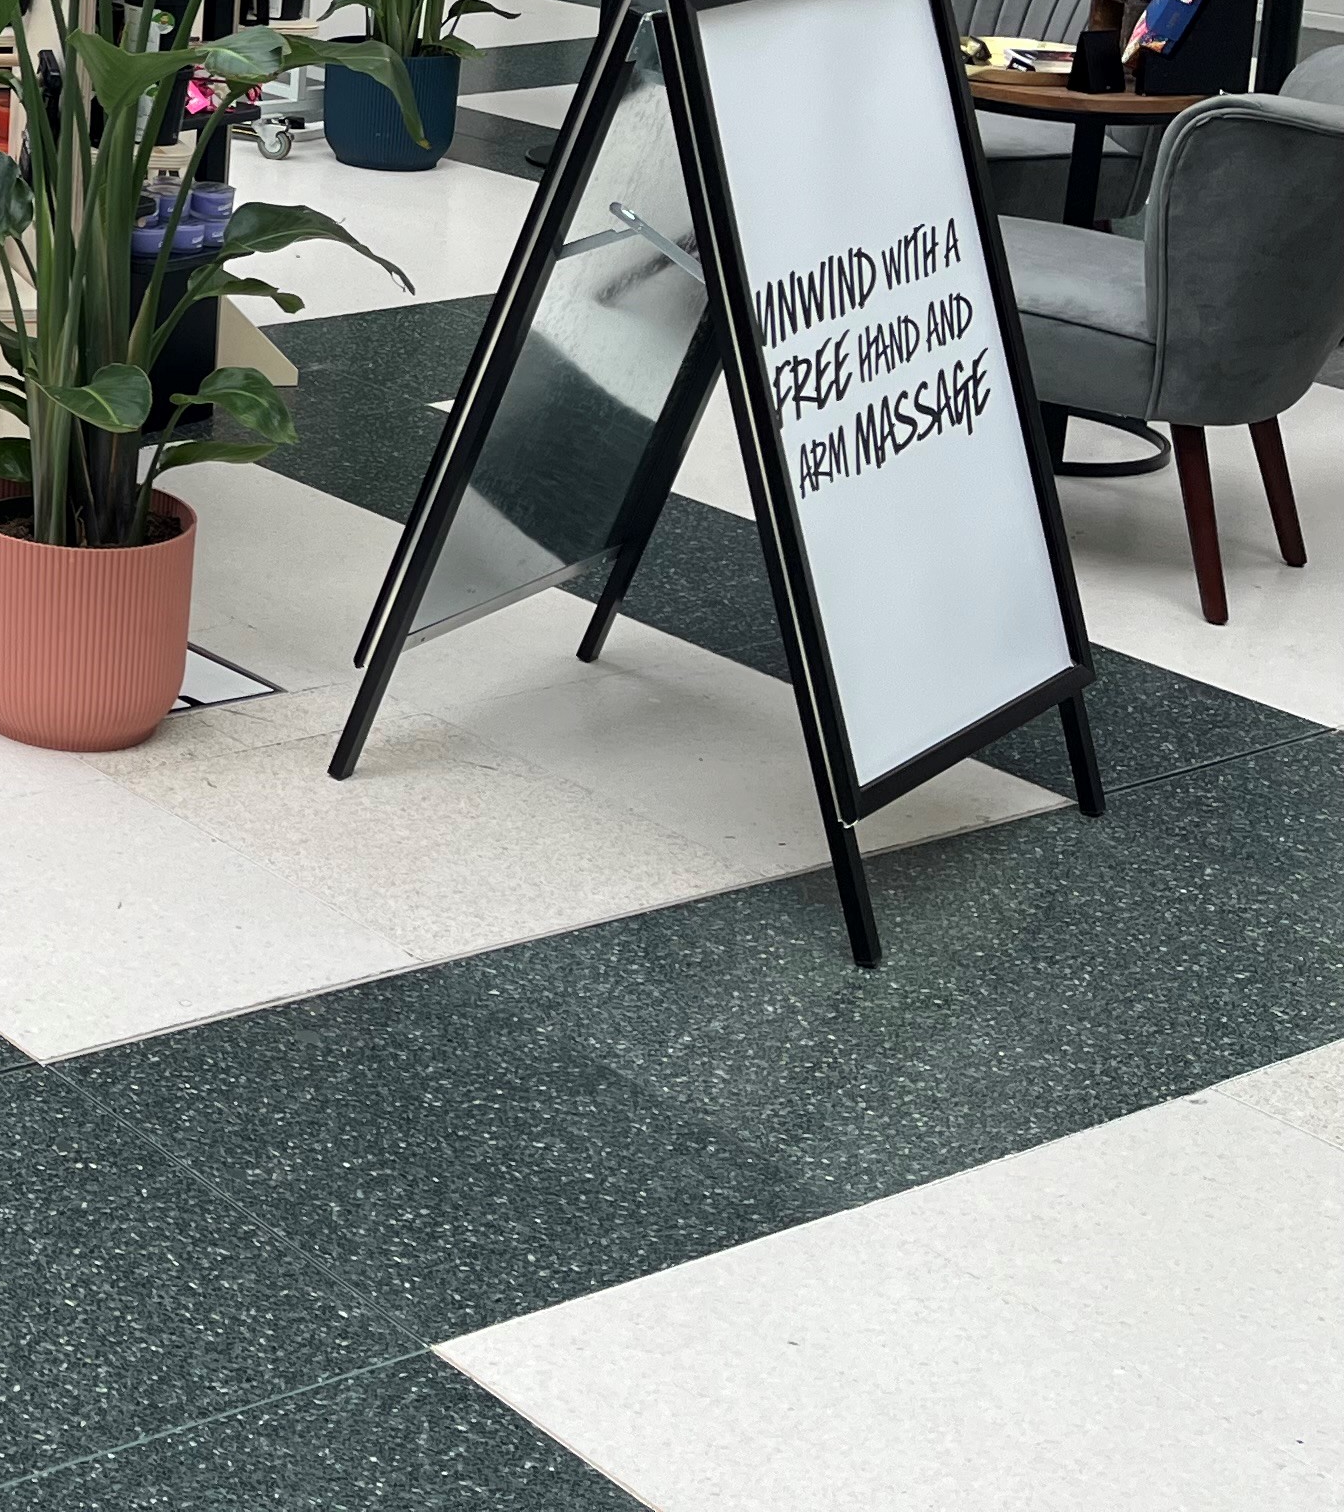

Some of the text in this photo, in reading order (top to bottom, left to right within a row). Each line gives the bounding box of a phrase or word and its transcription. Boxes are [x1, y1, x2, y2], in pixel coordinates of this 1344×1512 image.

[755, 218, 961, 349] UNWIND WITH A
[773, 292, 973, 429] FREE HAND AND
[800, 348, 991, 499] ARM MASSAGE
